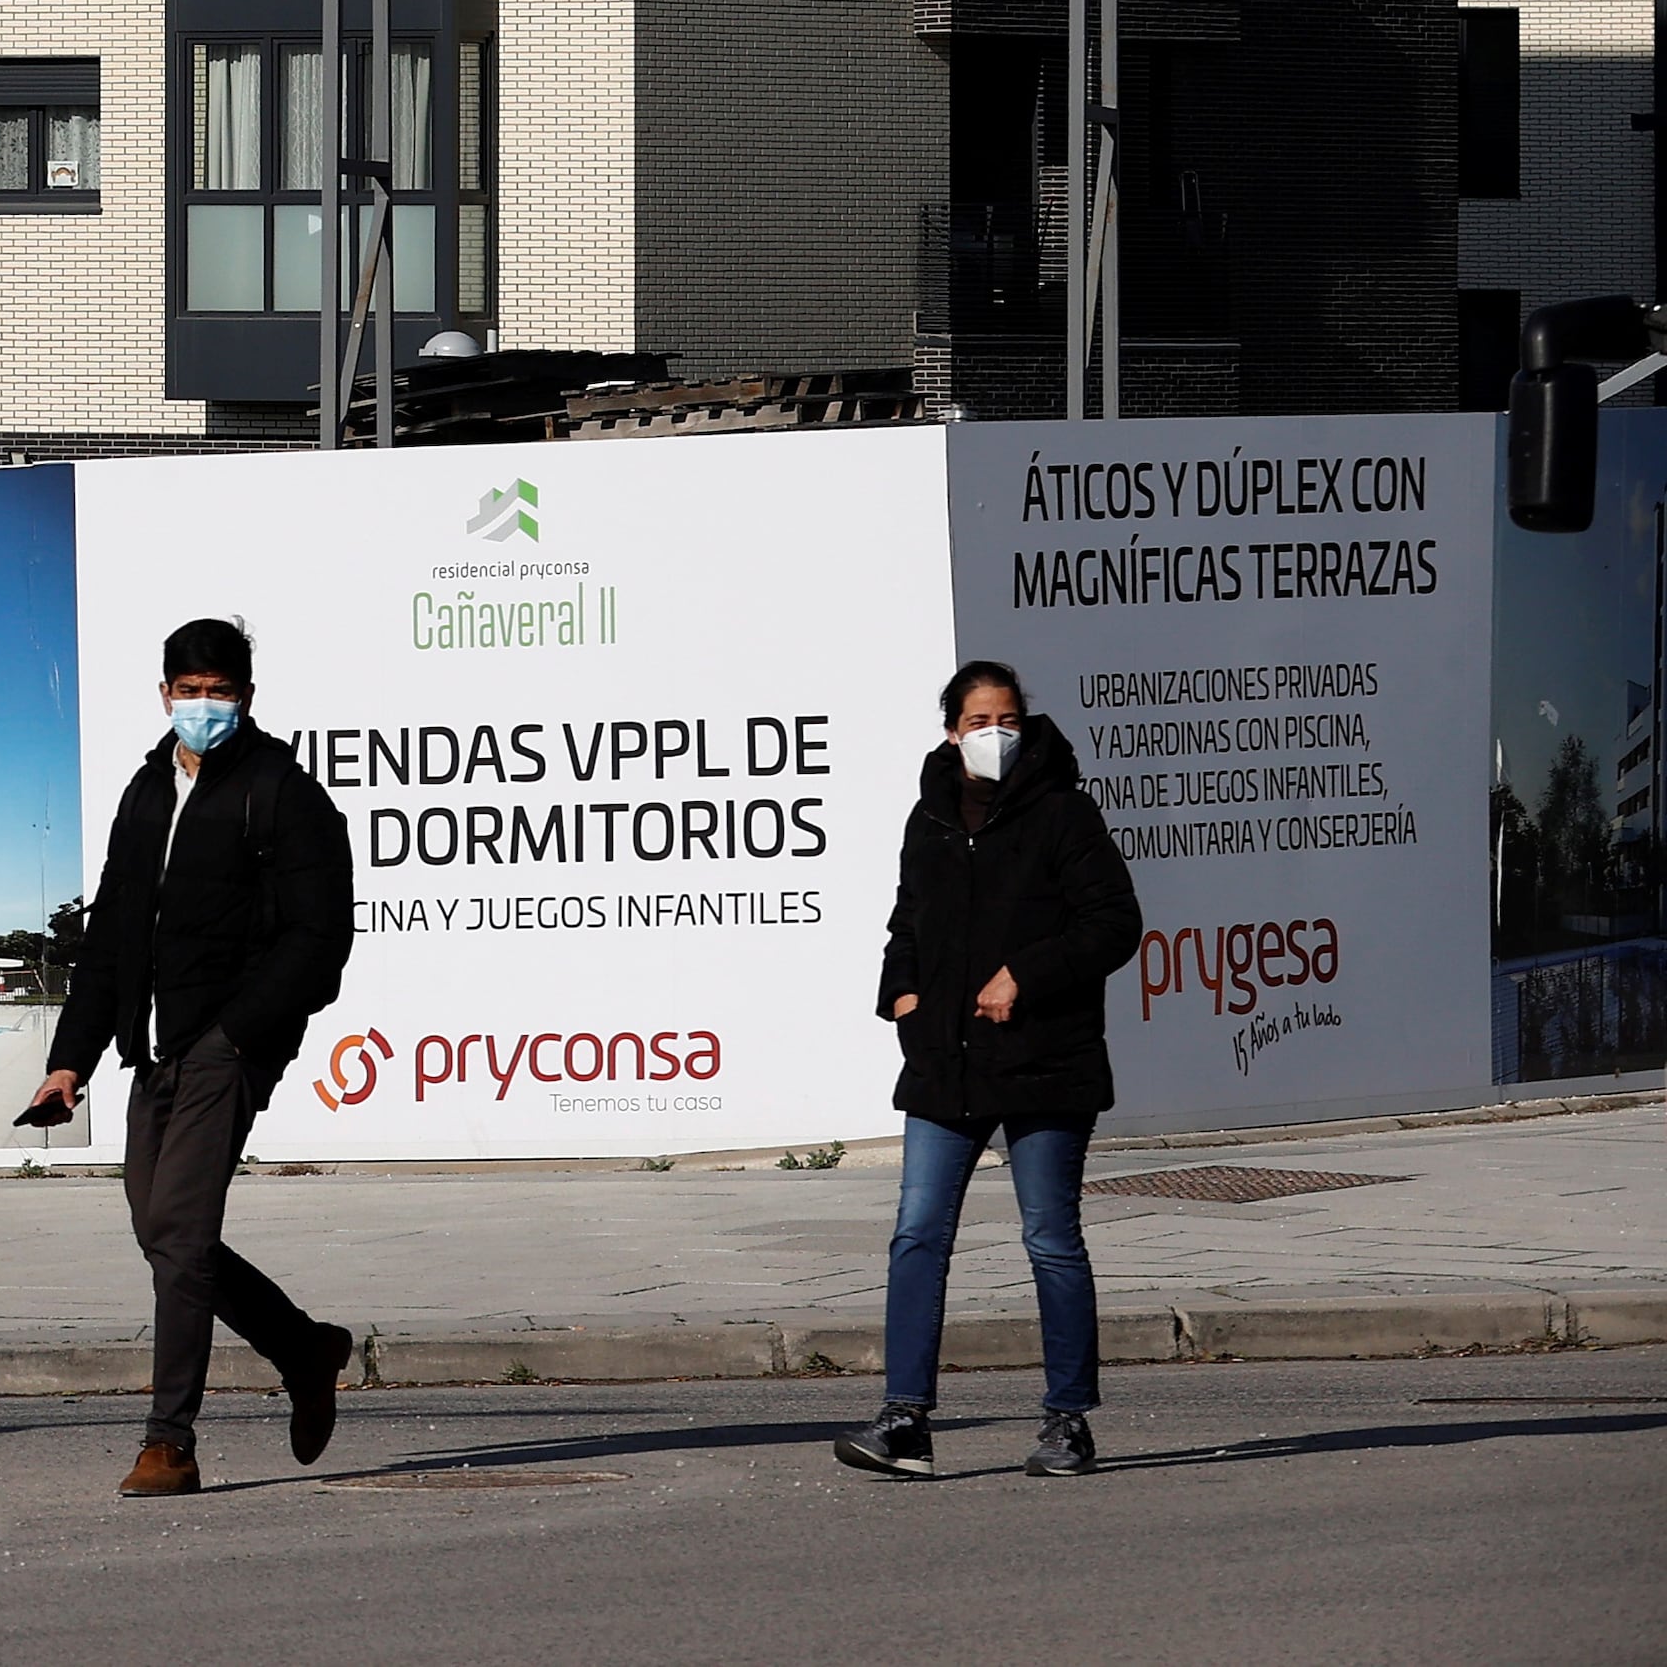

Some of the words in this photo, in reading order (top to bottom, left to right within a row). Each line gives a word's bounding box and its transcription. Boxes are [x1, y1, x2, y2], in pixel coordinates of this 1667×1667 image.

[1023, 451, 1155, 521] ÁTICOS
[1162, 462, 1187, 517] Y
[1197, 446, 1343, 516] DÚPLEX
[1352, 457, 1425, 512] CON
[433, 561, 514, 578] residencial
[521, 562, 589, 580] pryconsa
[1014, 534, 1241, 608] MAGNÍFICAS
[1249, 540, 1436, 599] TERRAZAS
[413, 582, 583, 649] Cañaveral
[1080, 667, 1269, 708] URBANIZACIONES
[1275, 663, 1377, 699] PRIVADAS
[291, 724, 546, 787] IENDAS
[562, 719, 729, 781] VPPL
[747, 716, 830, 776] DE
[1089, 726, 1104, 759] Y
[1109, 720, 1230, 758] AJARDINAS
[1236, 718, 1278, 751] CON
[1286, 714, 1370, 751] PISCINA,
[1141, 774, 1168, 808] DE
[1174, 769, 1258, 806] JUEGOS
[1264, 763, 1387, 801] INFANTILES,
[371, 798, 826, 867] DORMITORIOS
[1109, 816, 1255, 861] OMUNITARIA
[1258, 819, 1271, 851] Y
[1277, 803, 1417, 850] CONSERJERÍA
[354, 899, 428, 932] CINA
[437, 899, 459, 930] Y
[467, 896, 605, 930] JUEGOS
[619, 892, 821, 927] INFANTILES
[1141, 918, 1338, 1021] prygesa
[416, 1031, 720, 1102] pryconsa
[1234, 1030, 1248, 1076] 15
[1251, 1013, 1279, 1059] Años
[1283, 1016, 1291, 1034] a
[1295, 1002, 1310, 1027] tu
[1313, 1005, 1341, 1027] lado
[550, 1094, 640, 1112] Tenemos
[647, 1095, 666, 1111] tu
[674, 1097, 721, 1110] casa
